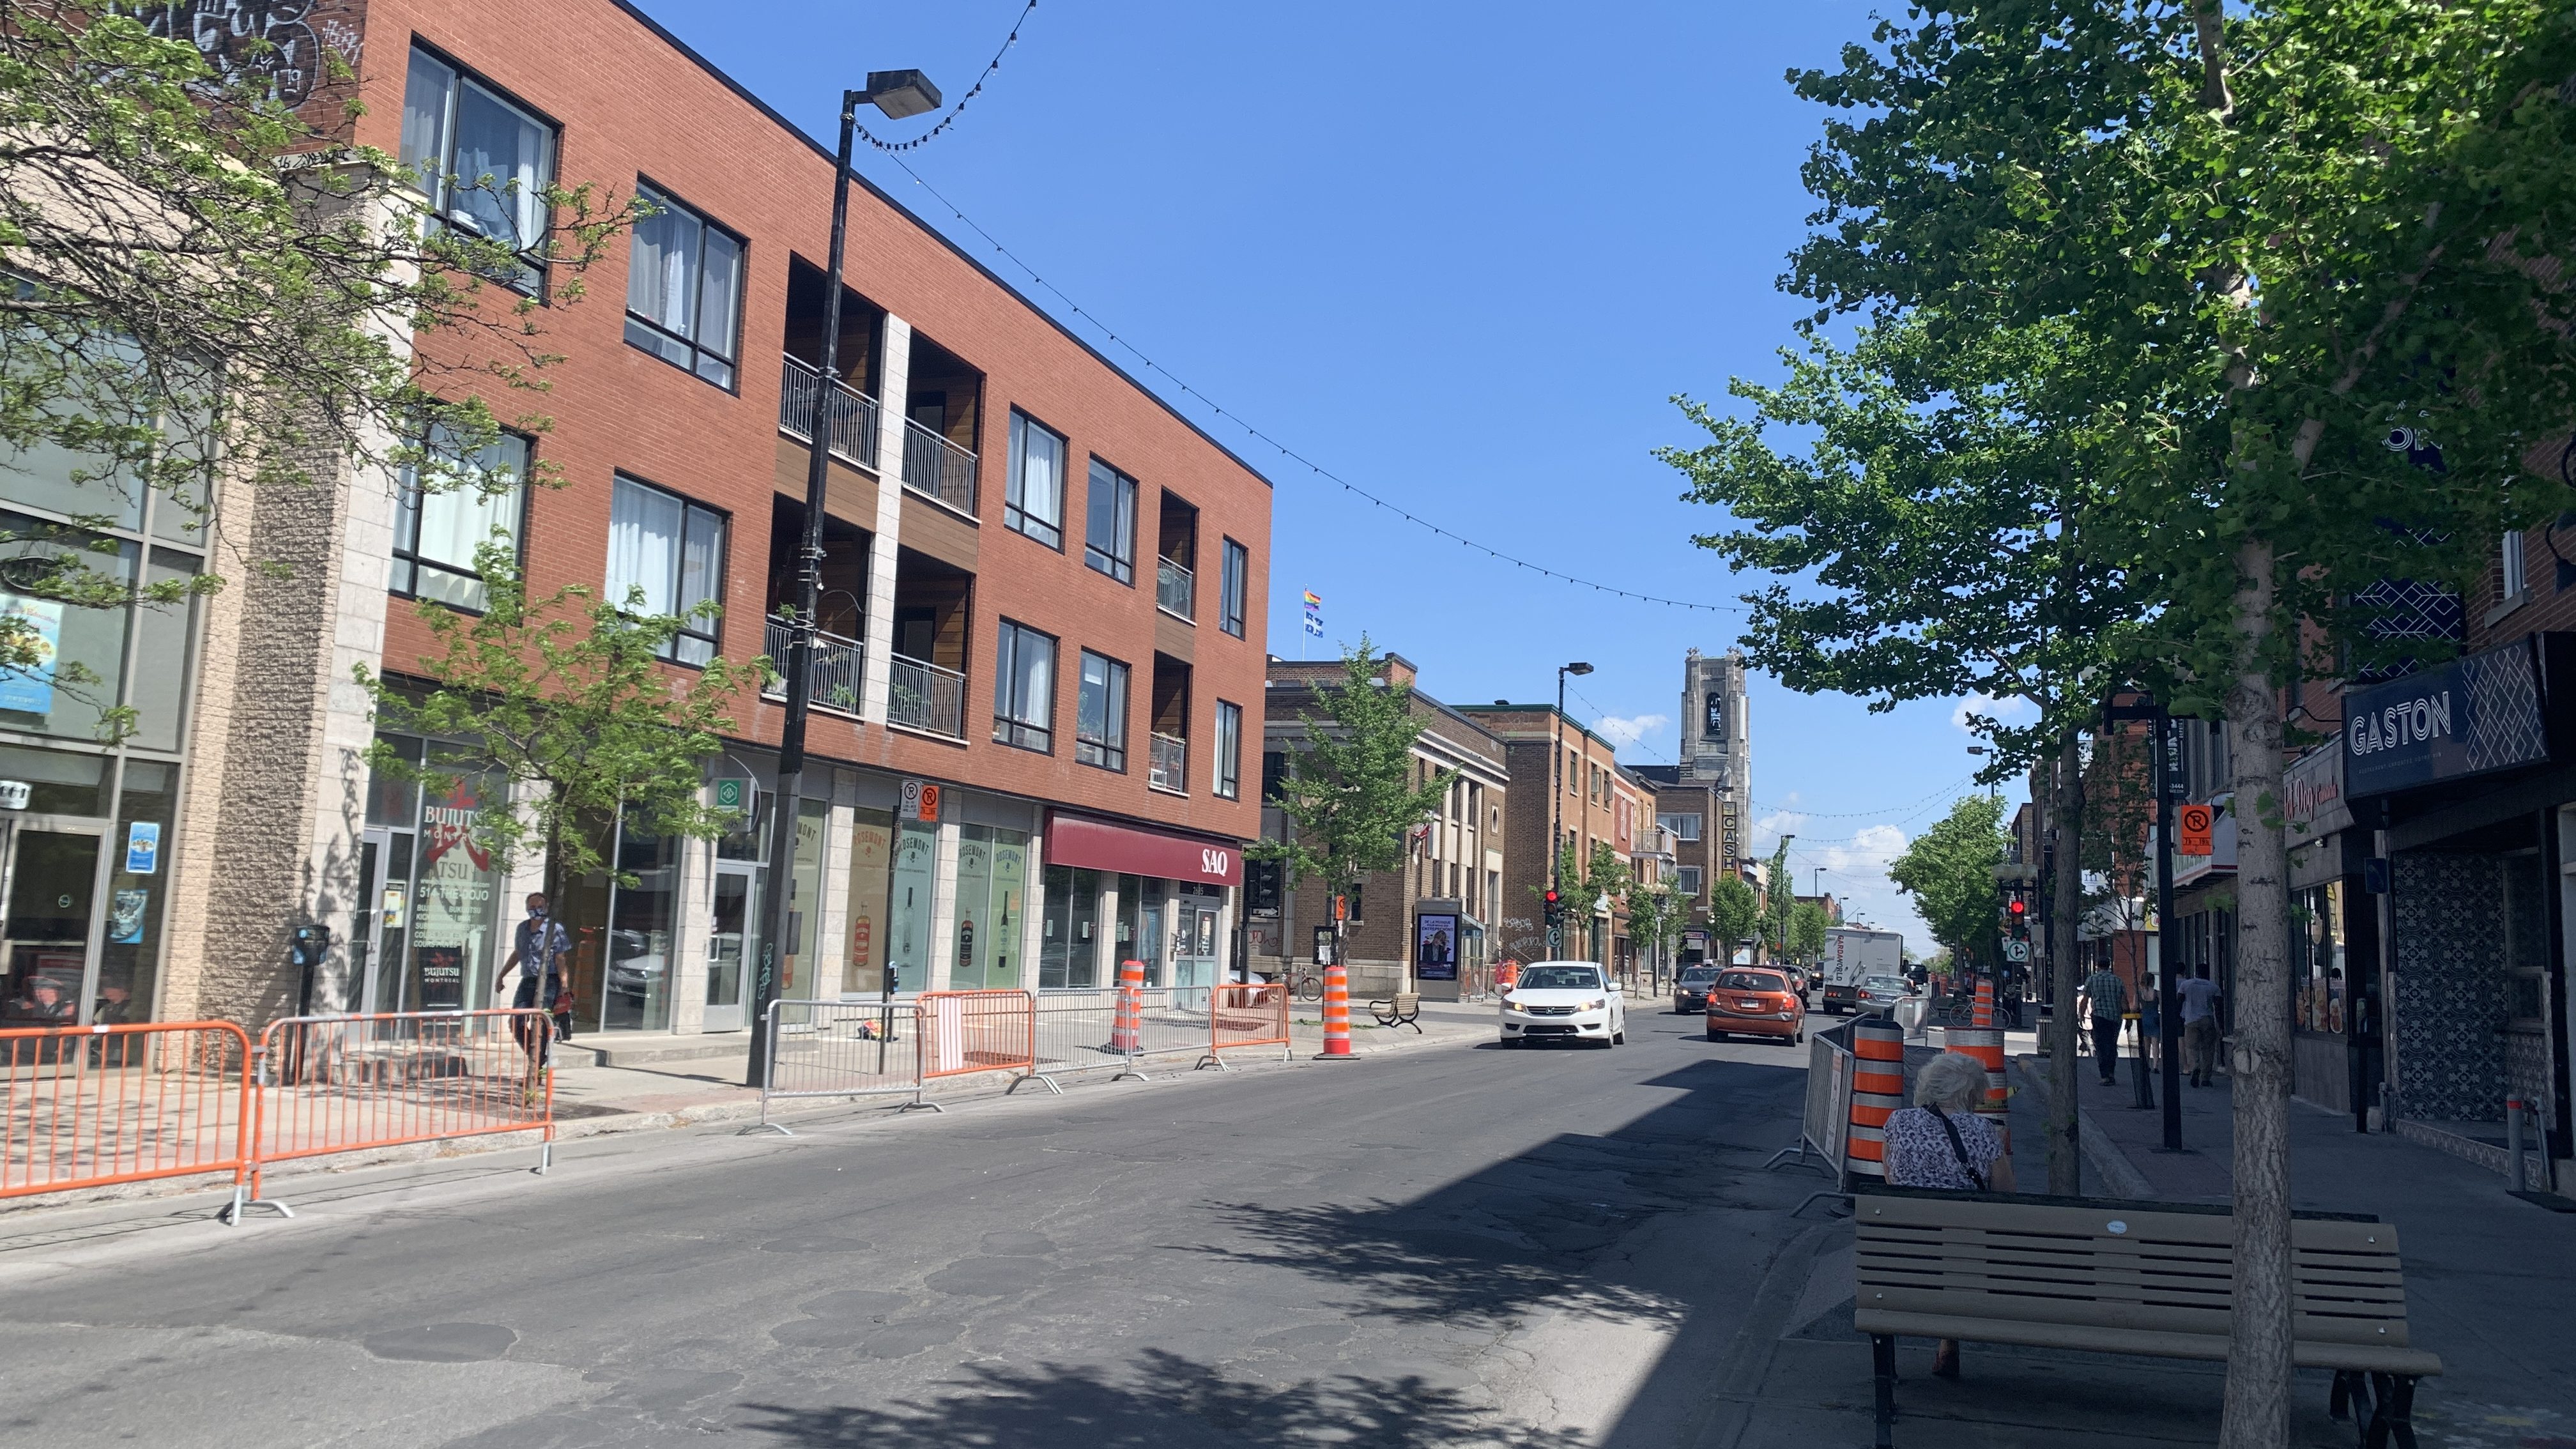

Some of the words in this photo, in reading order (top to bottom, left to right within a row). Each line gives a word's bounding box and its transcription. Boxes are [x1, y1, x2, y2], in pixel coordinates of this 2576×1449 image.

[2350, 691, 2451, 756] GASTON
[424, 806, 484, 827] BUJUTS
[902, 837, 929, 855] OSEMONT
[1724, 818, 1734, 868] CASH
[959, 845, 986, 861] ROSEMONT
[997, 849, 1021, 866] ROSEMONT
[1201, 848, 1227, 877] SAQ
[424, 967, 459, 976] BUJUTSU
